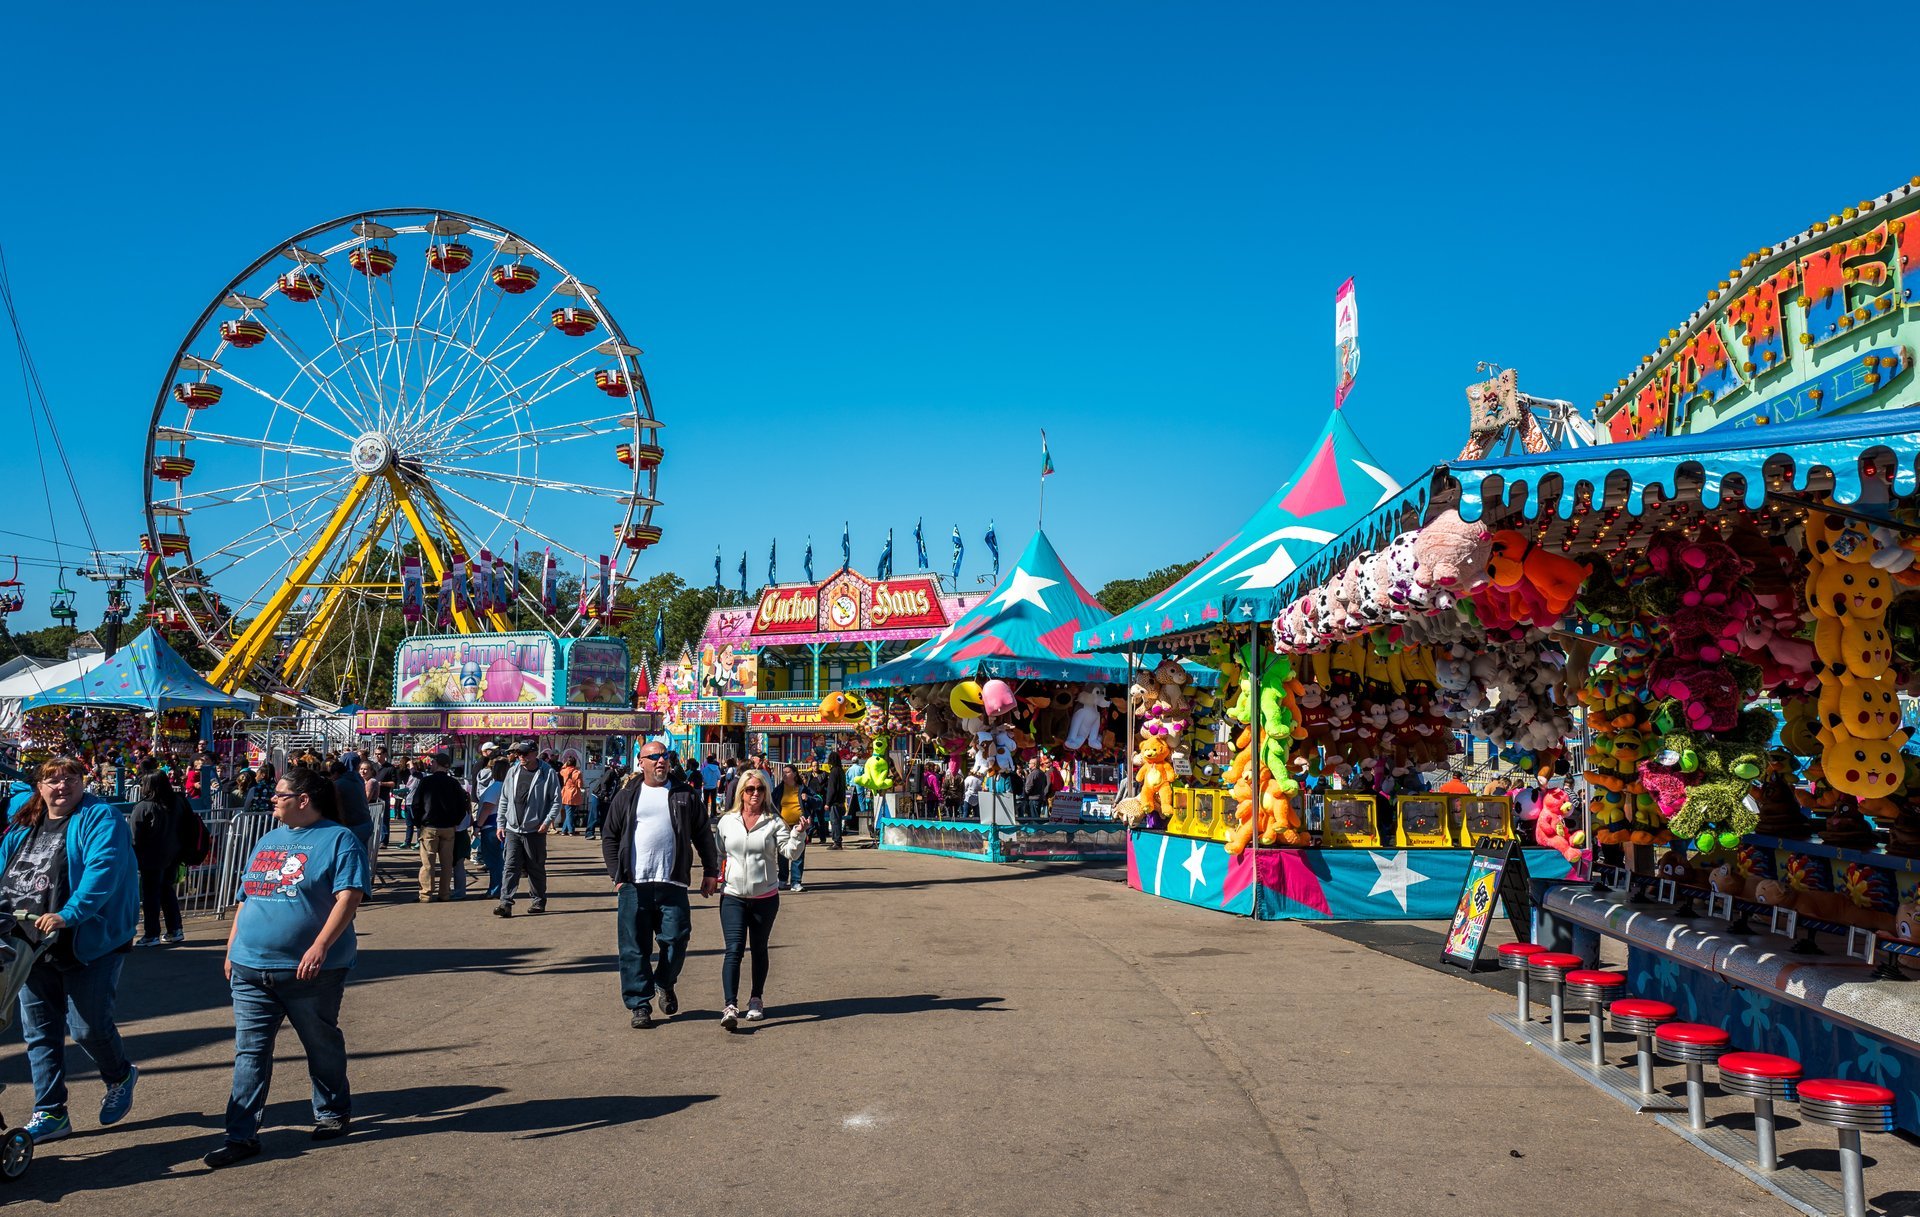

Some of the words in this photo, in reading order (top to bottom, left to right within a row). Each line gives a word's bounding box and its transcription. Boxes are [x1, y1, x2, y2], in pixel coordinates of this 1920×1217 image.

[1606, 210, 1920, 440] WATE
[757, 590, 818, 631] Cuckoo
[870, 583, 931, 625] Haus
[409, 715, 440, 727] CANDY
[450, 714, 481, 727] CANDY
[493, 714, 528, 727] APPLES
[589, 715, 610, 728] POP
[779, 713, 822, 723] FUN
[1777, 838, 1784, 849] 2
[255, 850, 289, 861] ONE
[1836, 847, 1843, 860] 3
[1905, 858, 1912, 872] 4
